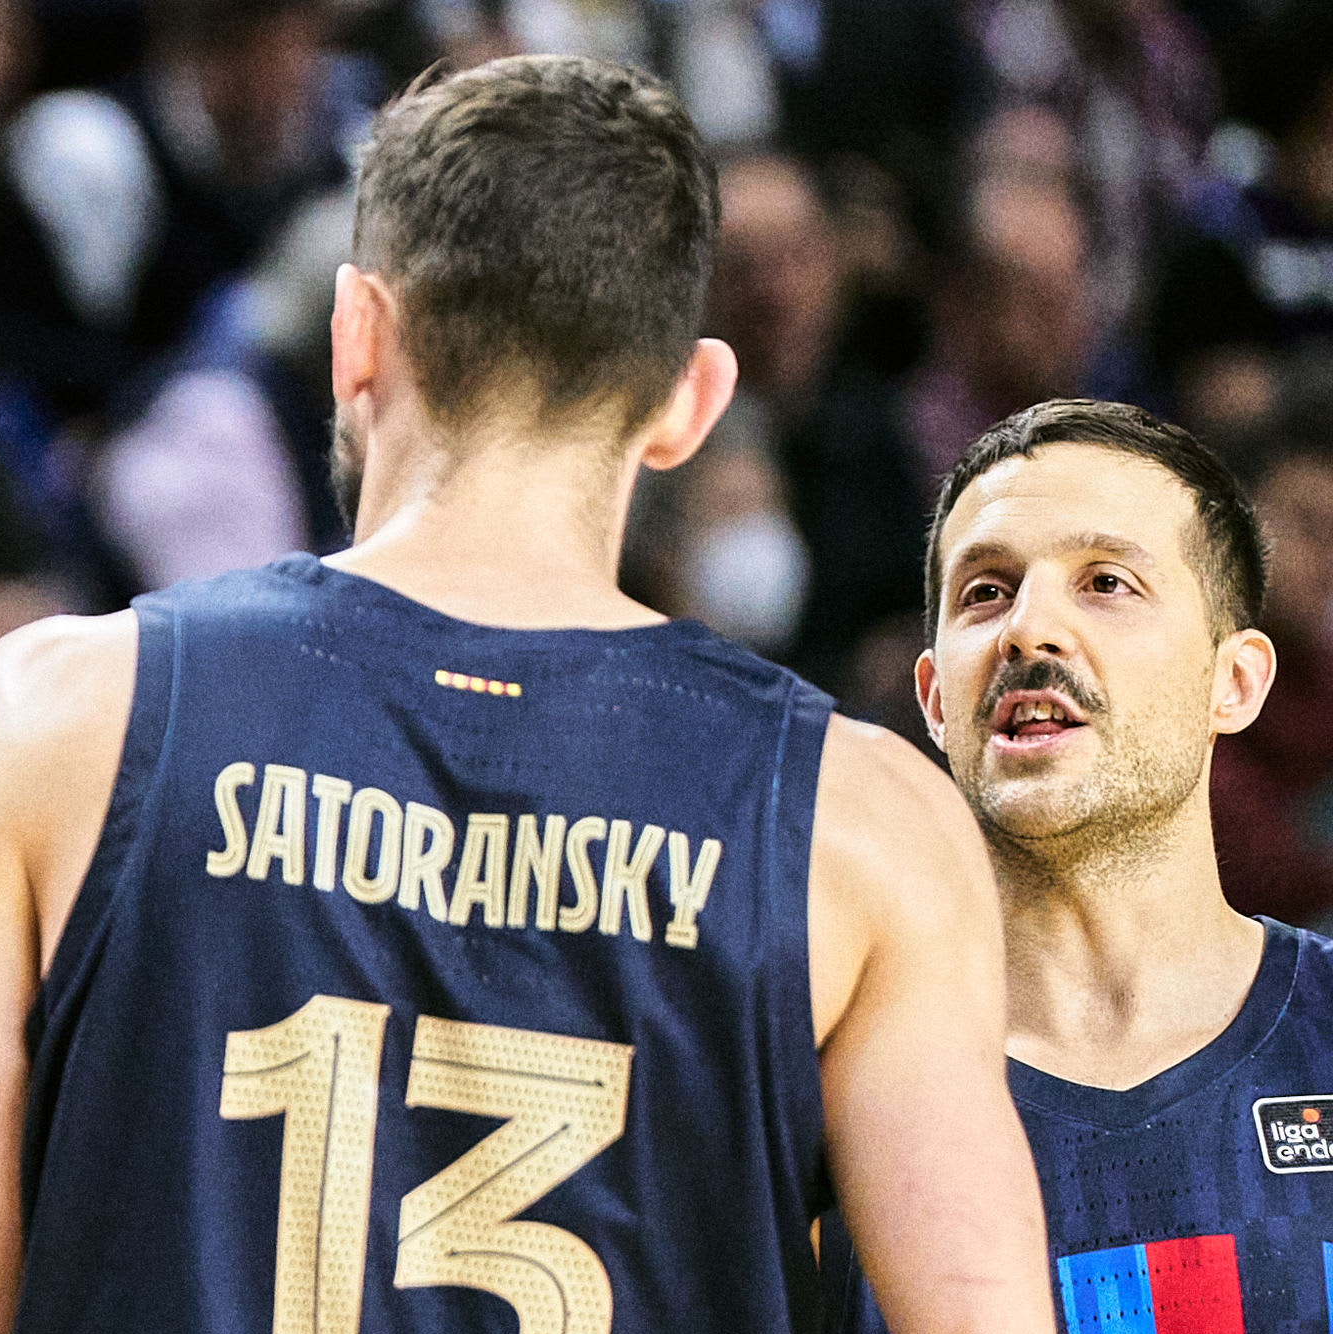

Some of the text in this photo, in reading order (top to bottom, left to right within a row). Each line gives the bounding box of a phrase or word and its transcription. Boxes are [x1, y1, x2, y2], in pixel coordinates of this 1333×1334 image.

[206, 762, 723, 949] SATORANSKY
[1270, 1120, 1320, 1143] liga
[1276, 1138, 1333, 1161] end
